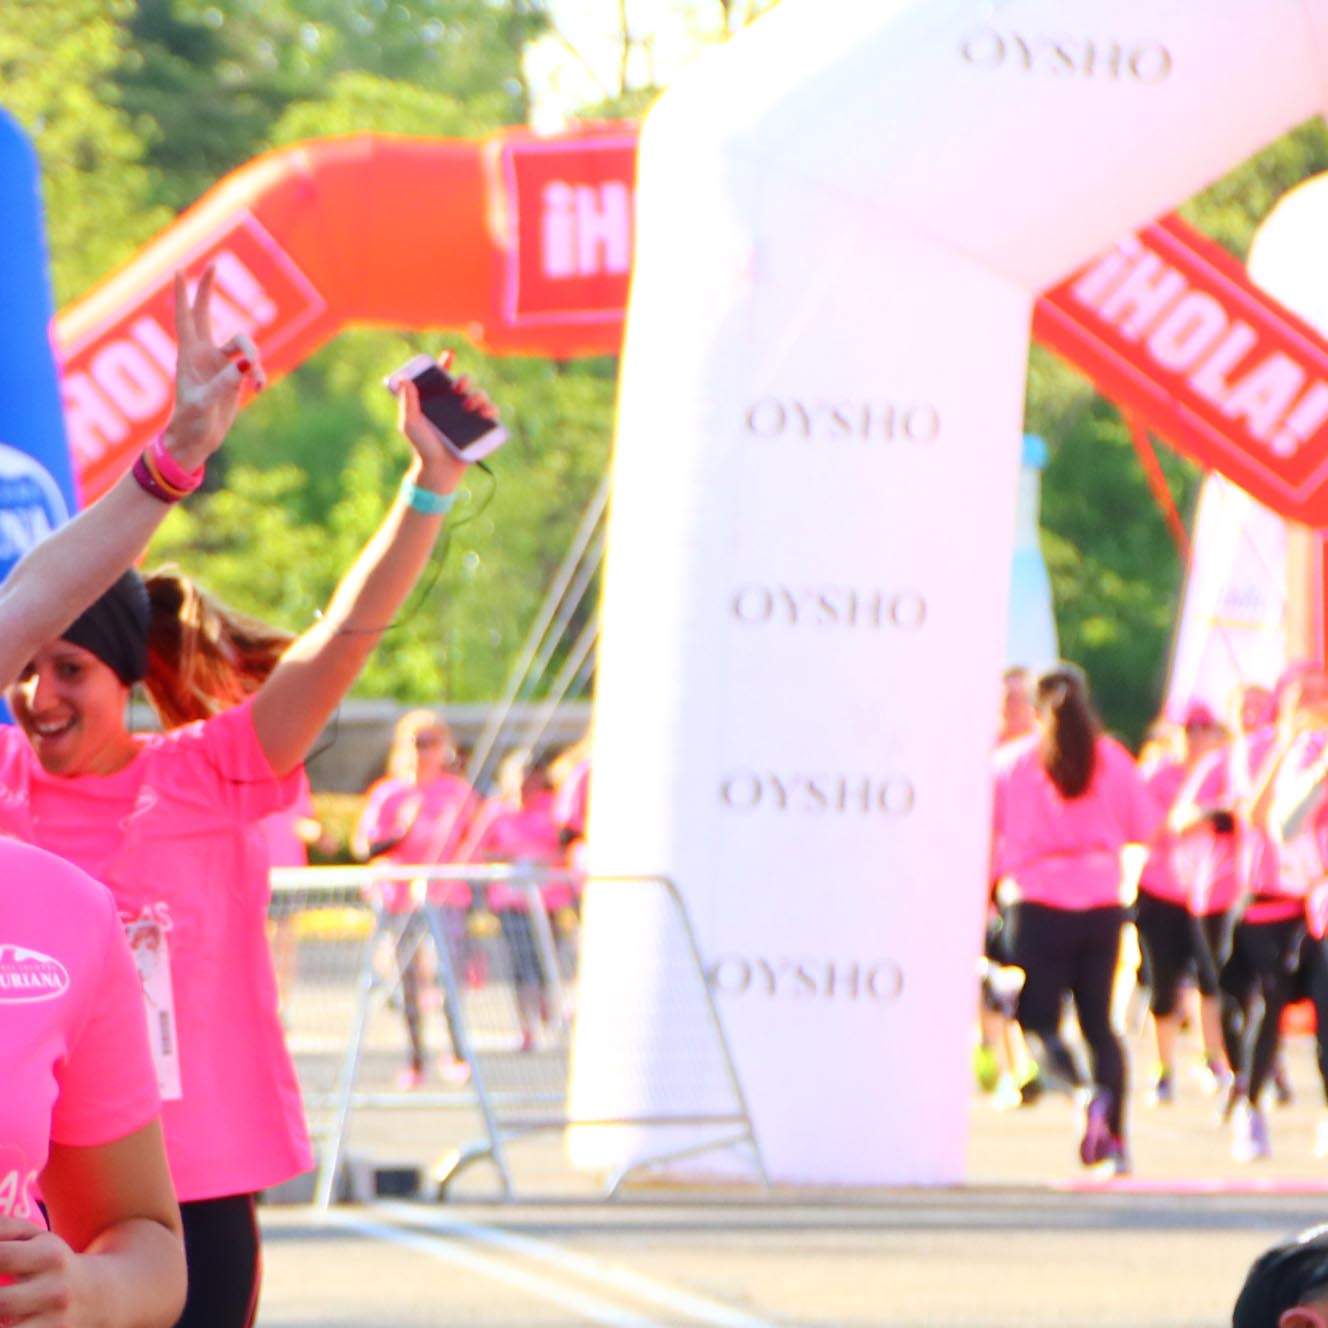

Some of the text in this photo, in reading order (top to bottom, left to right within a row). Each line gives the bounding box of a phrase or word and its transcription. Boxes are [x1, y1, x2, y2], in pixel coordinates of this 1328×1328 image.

[959, 30, 1172, 84] OYSHO
[744, 396, 941, 445] OYSHO
[732, 582, 928, 633] OYSHO
[720, 769, 916, 819] OYSHO
[708, 954, 905, 1004] OYSHO
